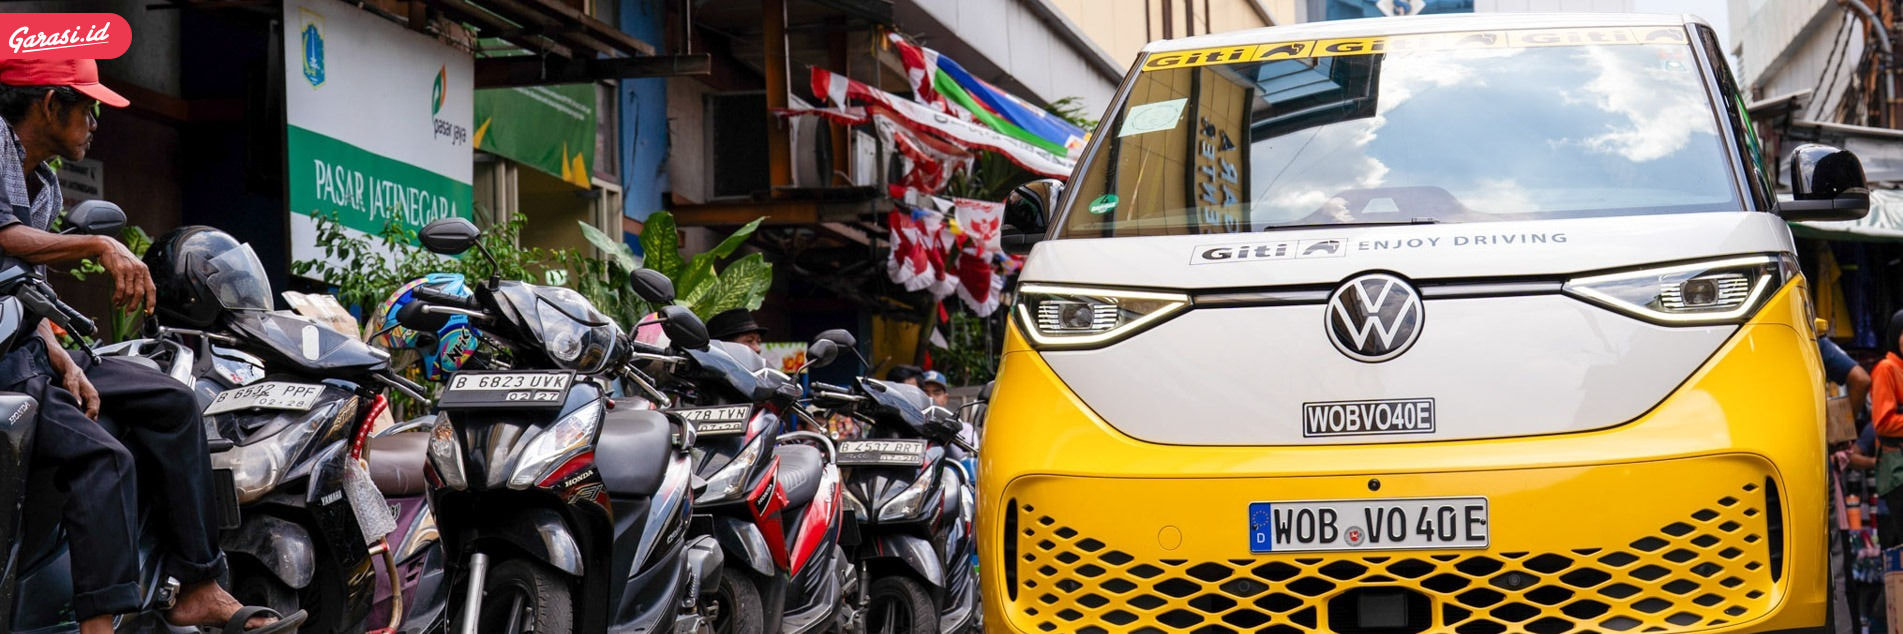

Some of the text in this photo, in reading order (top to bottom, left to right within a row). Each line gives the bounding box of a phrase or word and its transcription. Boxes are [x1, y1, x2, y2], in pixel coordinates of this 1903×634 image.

[1147, 48, 1245, 68] Giti
[433, 118, 466, 146] pasar jaya
[314, 159, 366, 212] PASAR
[1202, 233, 1568, 260] Giti ENJOY DRIVING
[456, 375, 566, 389] B 6823 UVK
[217, 392, 228, 403] B
[283, 385, 316, 398] PPF
[719, 408, 745, 419] TVN
[842, 443, 849, 452] B
[895, 443, 921, 453] BRT
[565, 469, 594, 488] HONDA
[1274, 508, 1339, 545] WOB
[1256, 532, 1266, 544] D
